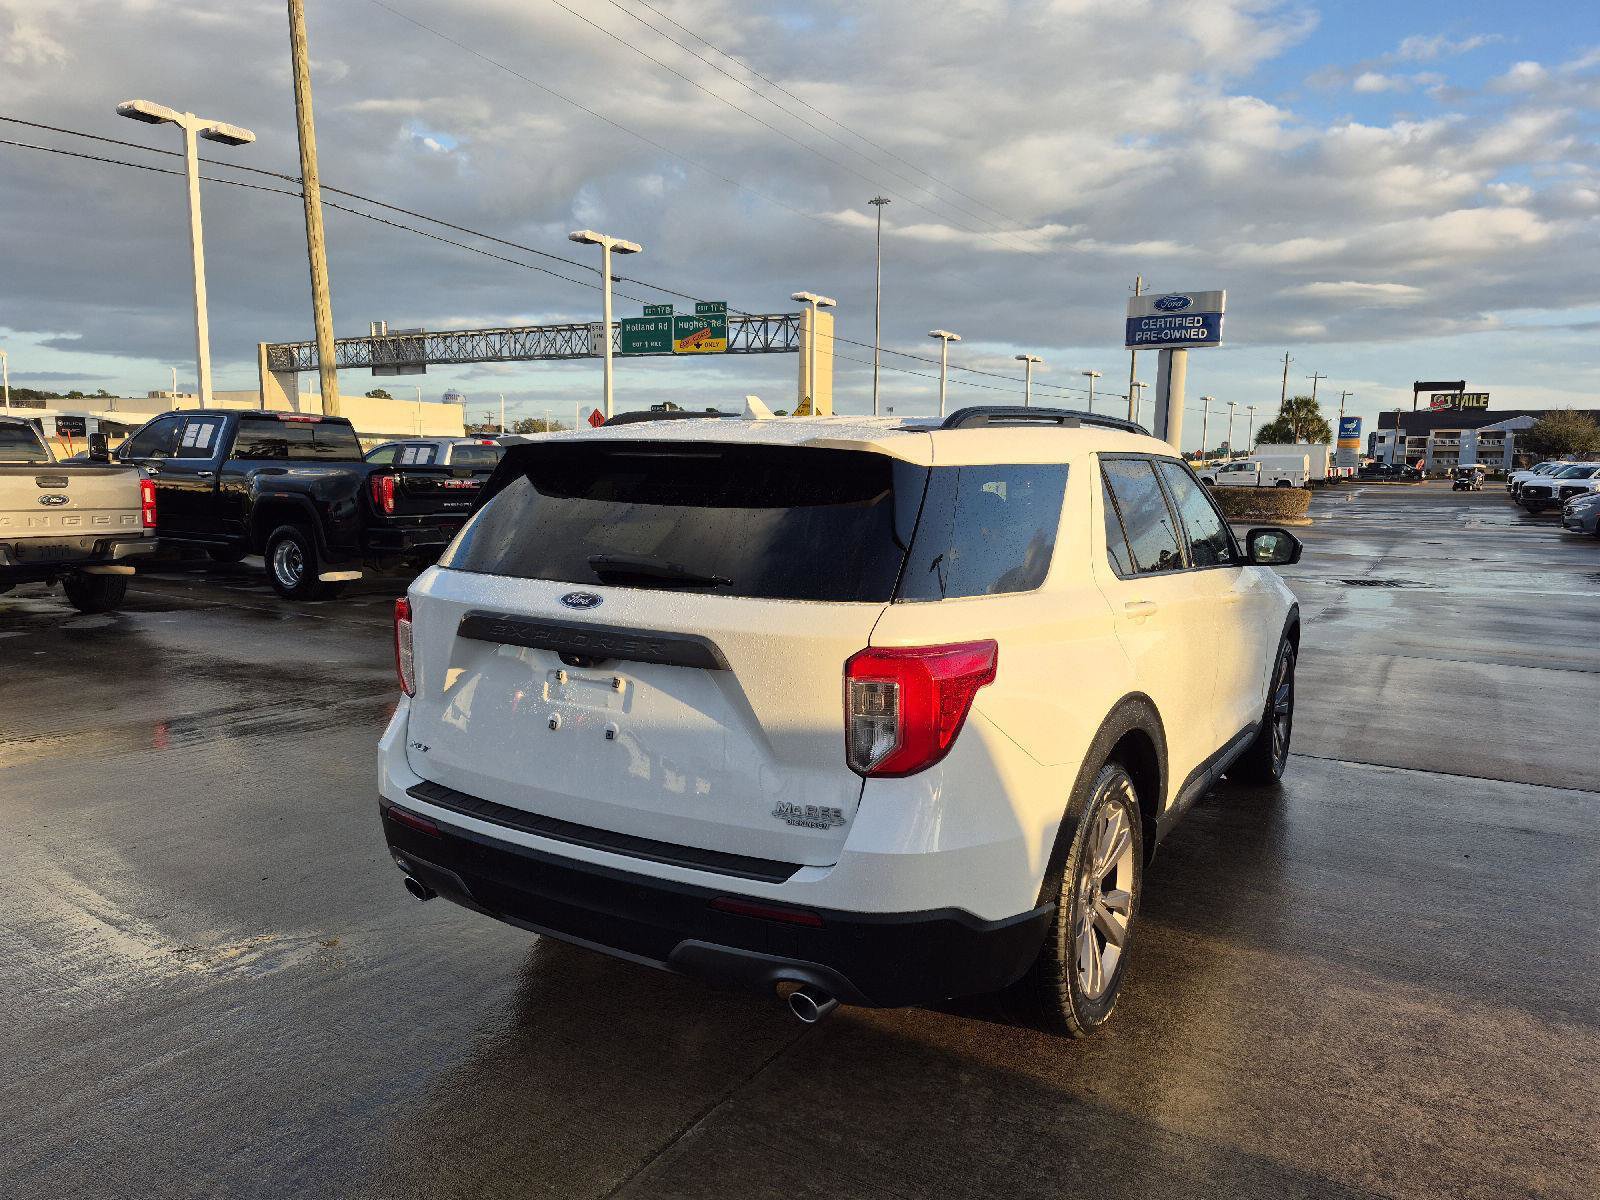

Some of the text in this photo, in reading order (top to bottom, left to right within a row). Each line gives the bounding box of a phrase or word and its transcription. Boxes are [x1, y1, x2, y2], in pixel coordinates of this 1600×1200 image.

[1161, 298, 1183, 308] Ford
[626, 322, 668, 332] Holland Rd
[679, 320, 708, 331] Hughes
[1141, 317, 1203, 329] CERTIFIED
[1135, 329, 1208, 341] PRE-OWNED
[490, 624, 666, 656] EXPLORER
